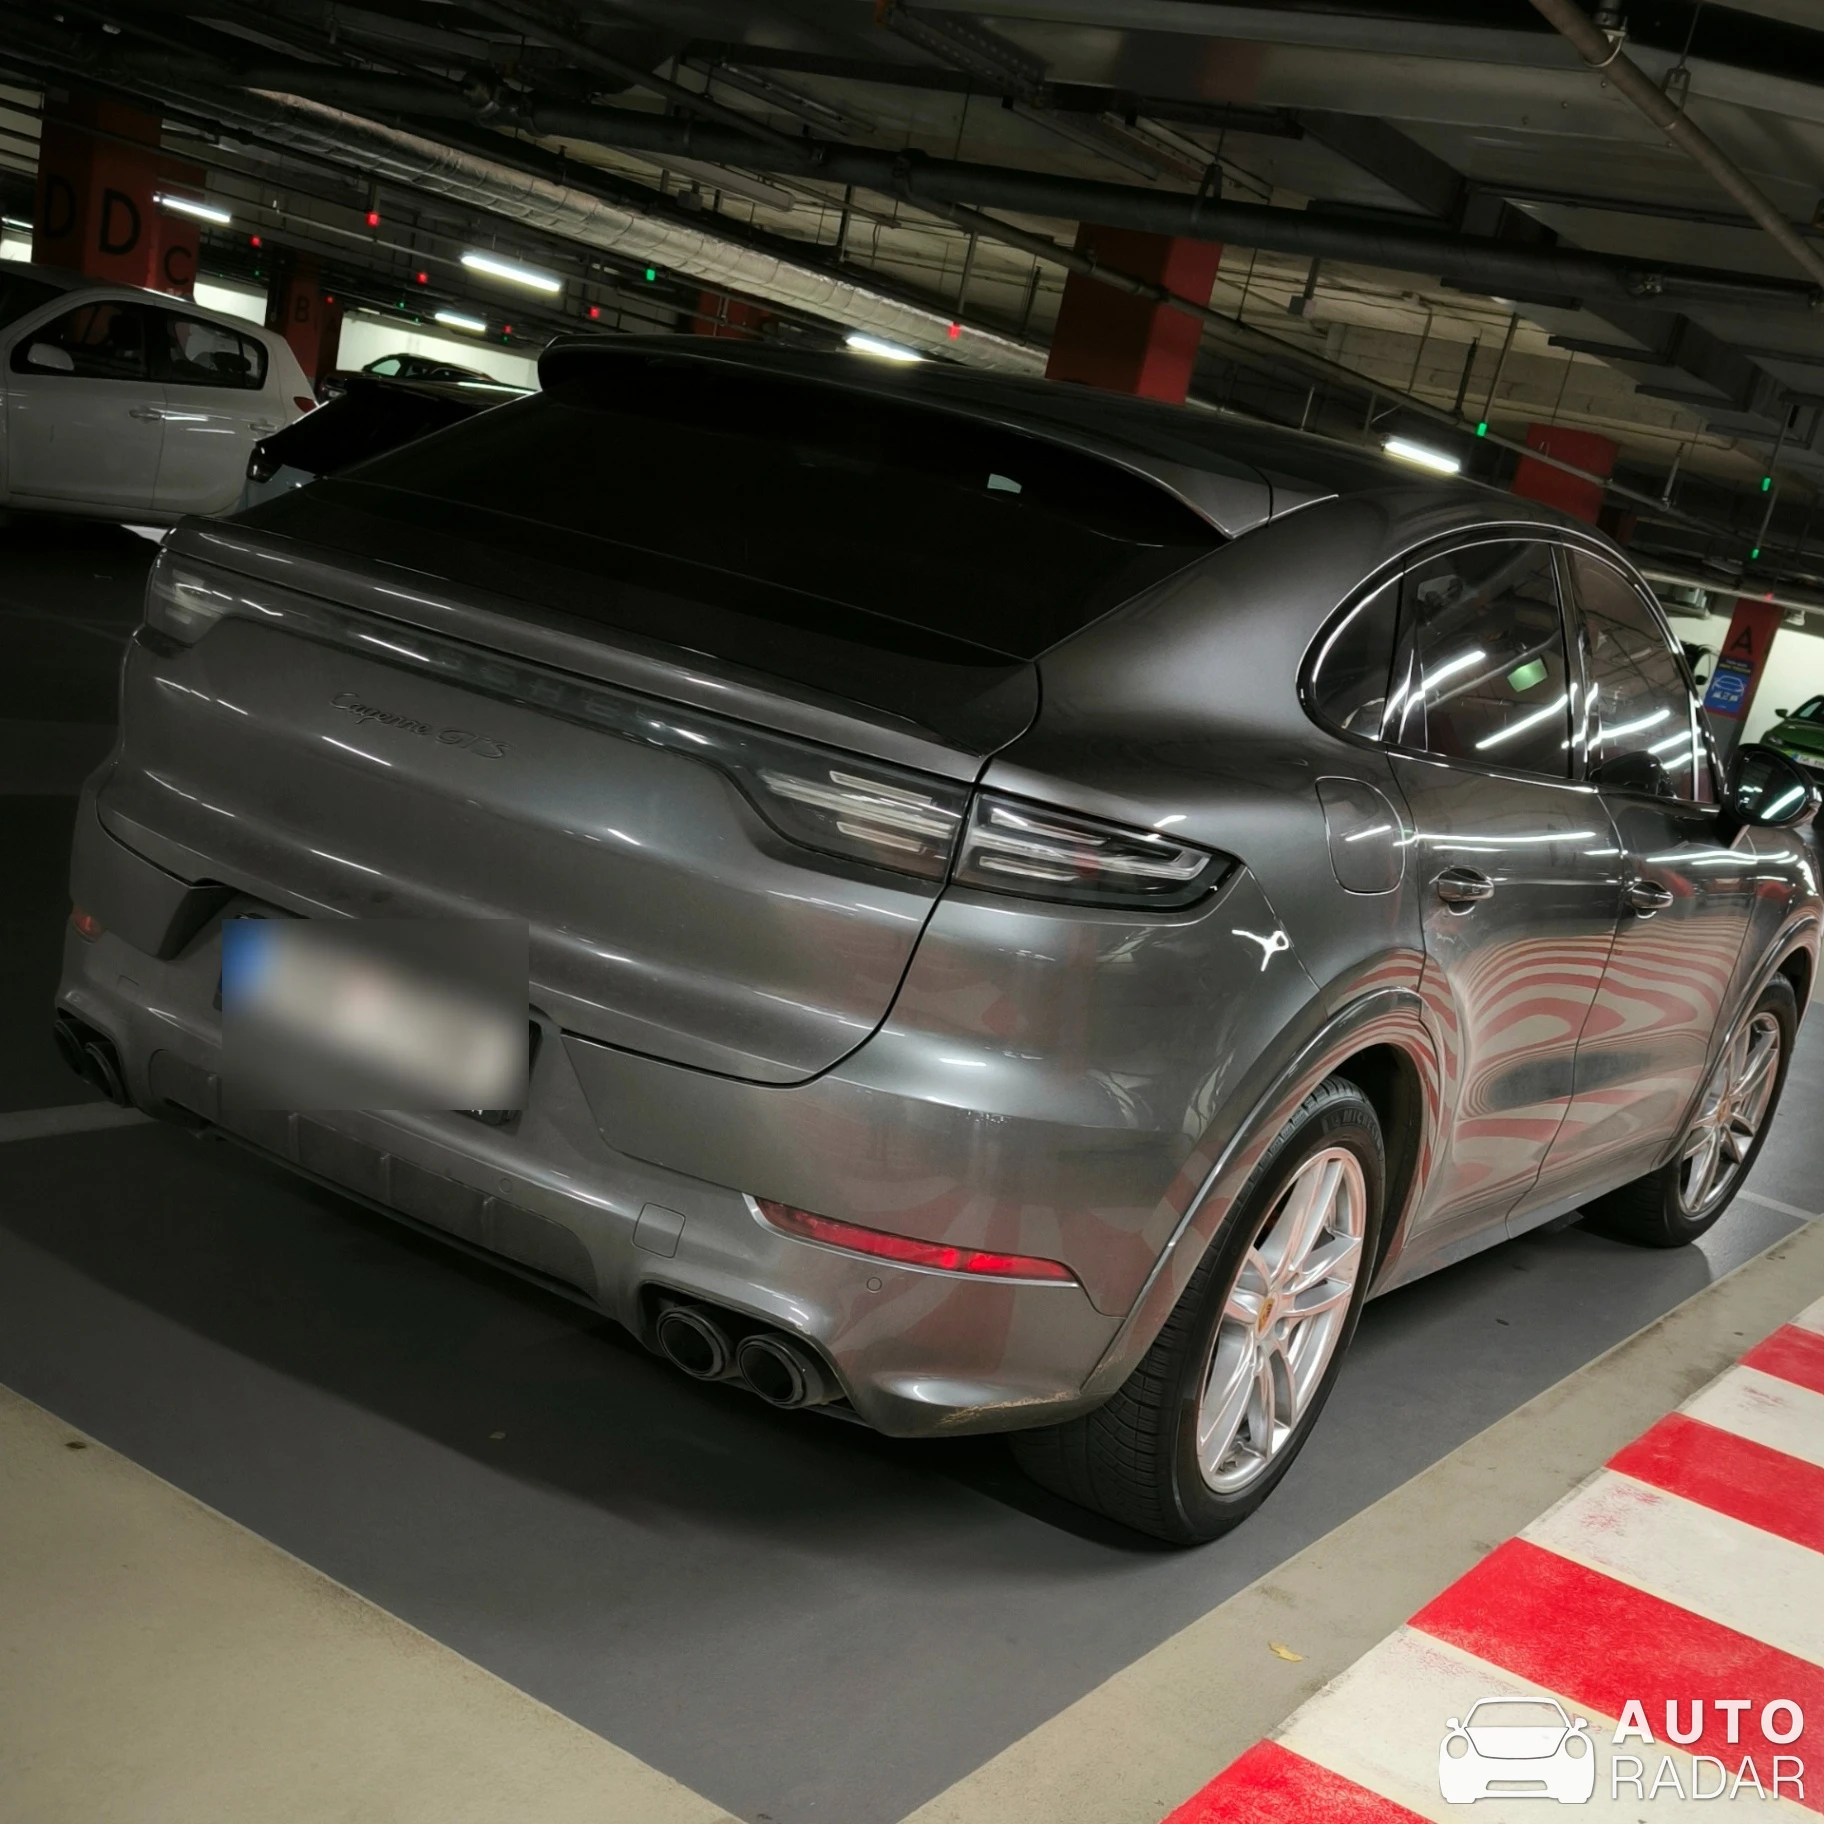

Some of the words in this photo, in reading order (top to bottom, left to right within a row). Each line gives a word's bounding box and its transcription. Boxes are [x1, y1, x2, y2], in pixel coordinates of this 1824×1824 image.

[44, 173, 76, 239] D
[99, 188, 141, 255] D
[163, 246, 192, 286] C
[295, 295, 310, 323] B
[1730, 625, 1752, 655] A
[330, 692, 432, 736] Cayenne
[436, 727, 511, 759] GTS
